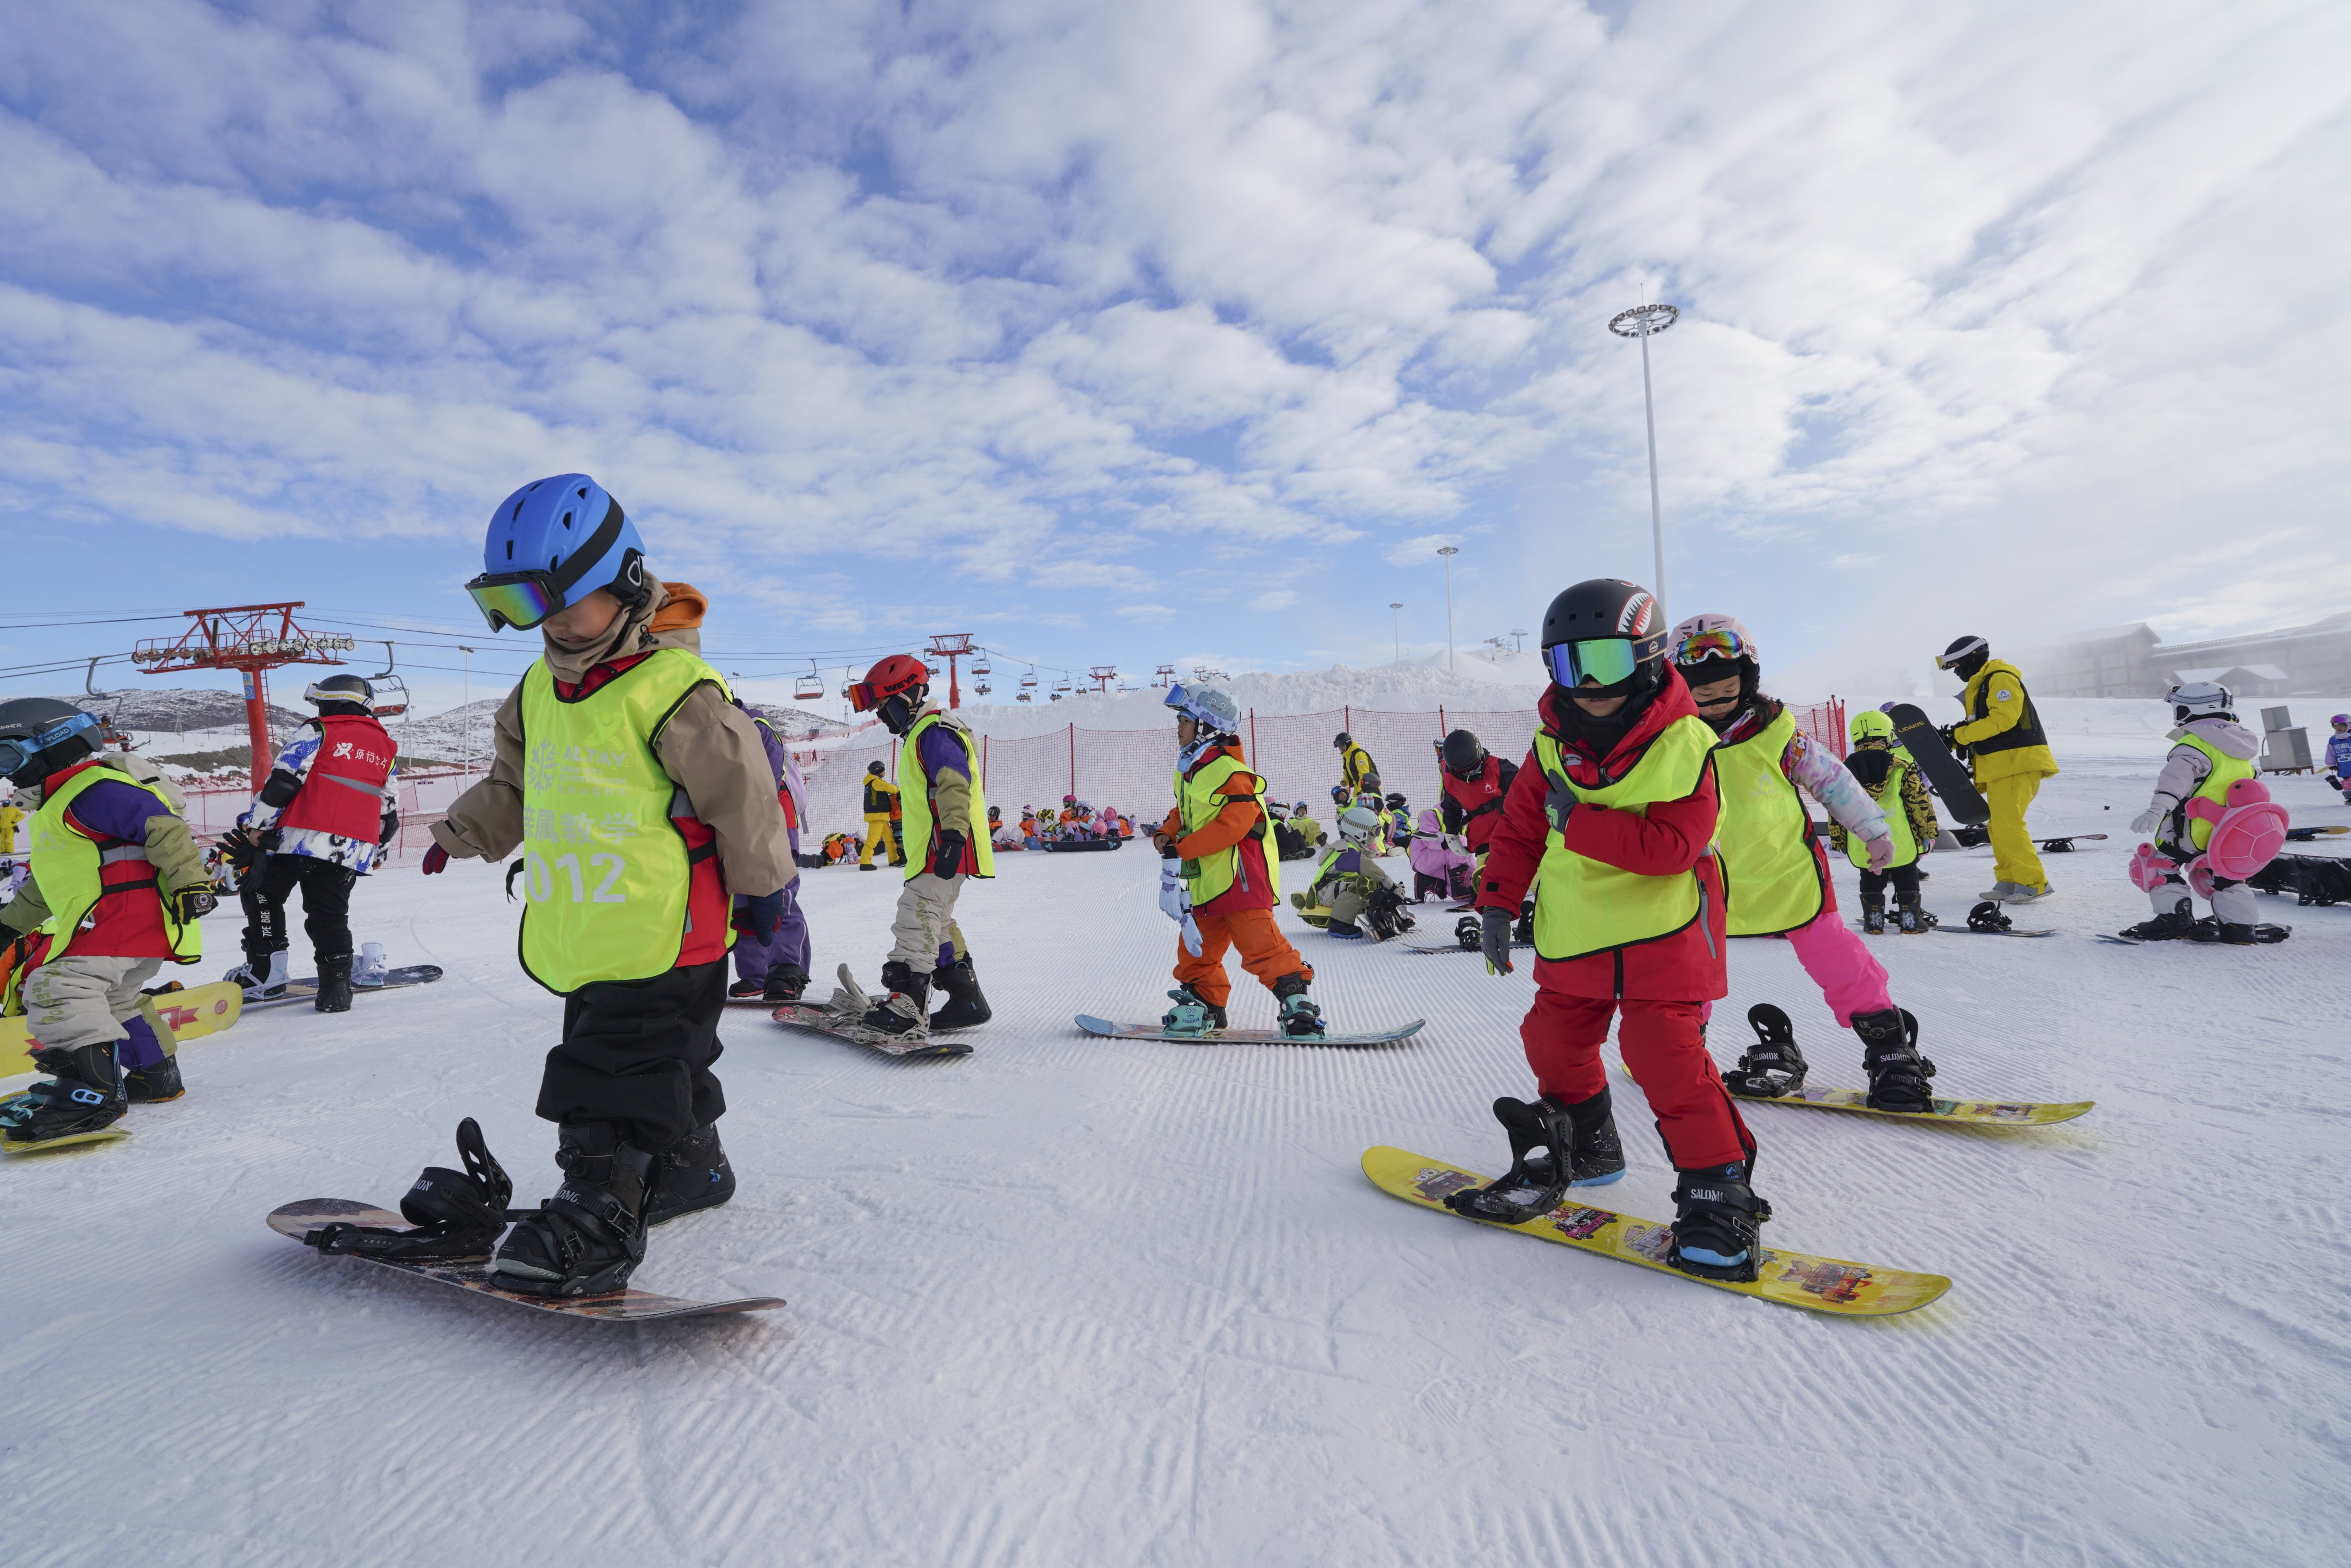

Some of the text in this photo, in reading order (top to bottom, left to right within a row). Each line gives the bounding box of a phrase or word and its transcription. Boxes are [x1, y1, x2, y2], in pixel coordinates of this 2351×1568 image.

[883, 673, 919, 692] WEYA
[324, 694, 364, 702] MOTION
[1898, 721, 1924, 733] LIDAKIS
[45, 728, 69, 742] VLOAD
[563, 744, 627, 767] ALTAY
[2337, 753, 2351, 763] 25
[526, 851, 626, 903] 012
[1752, 1052, 1779, 1062] SALOMON
